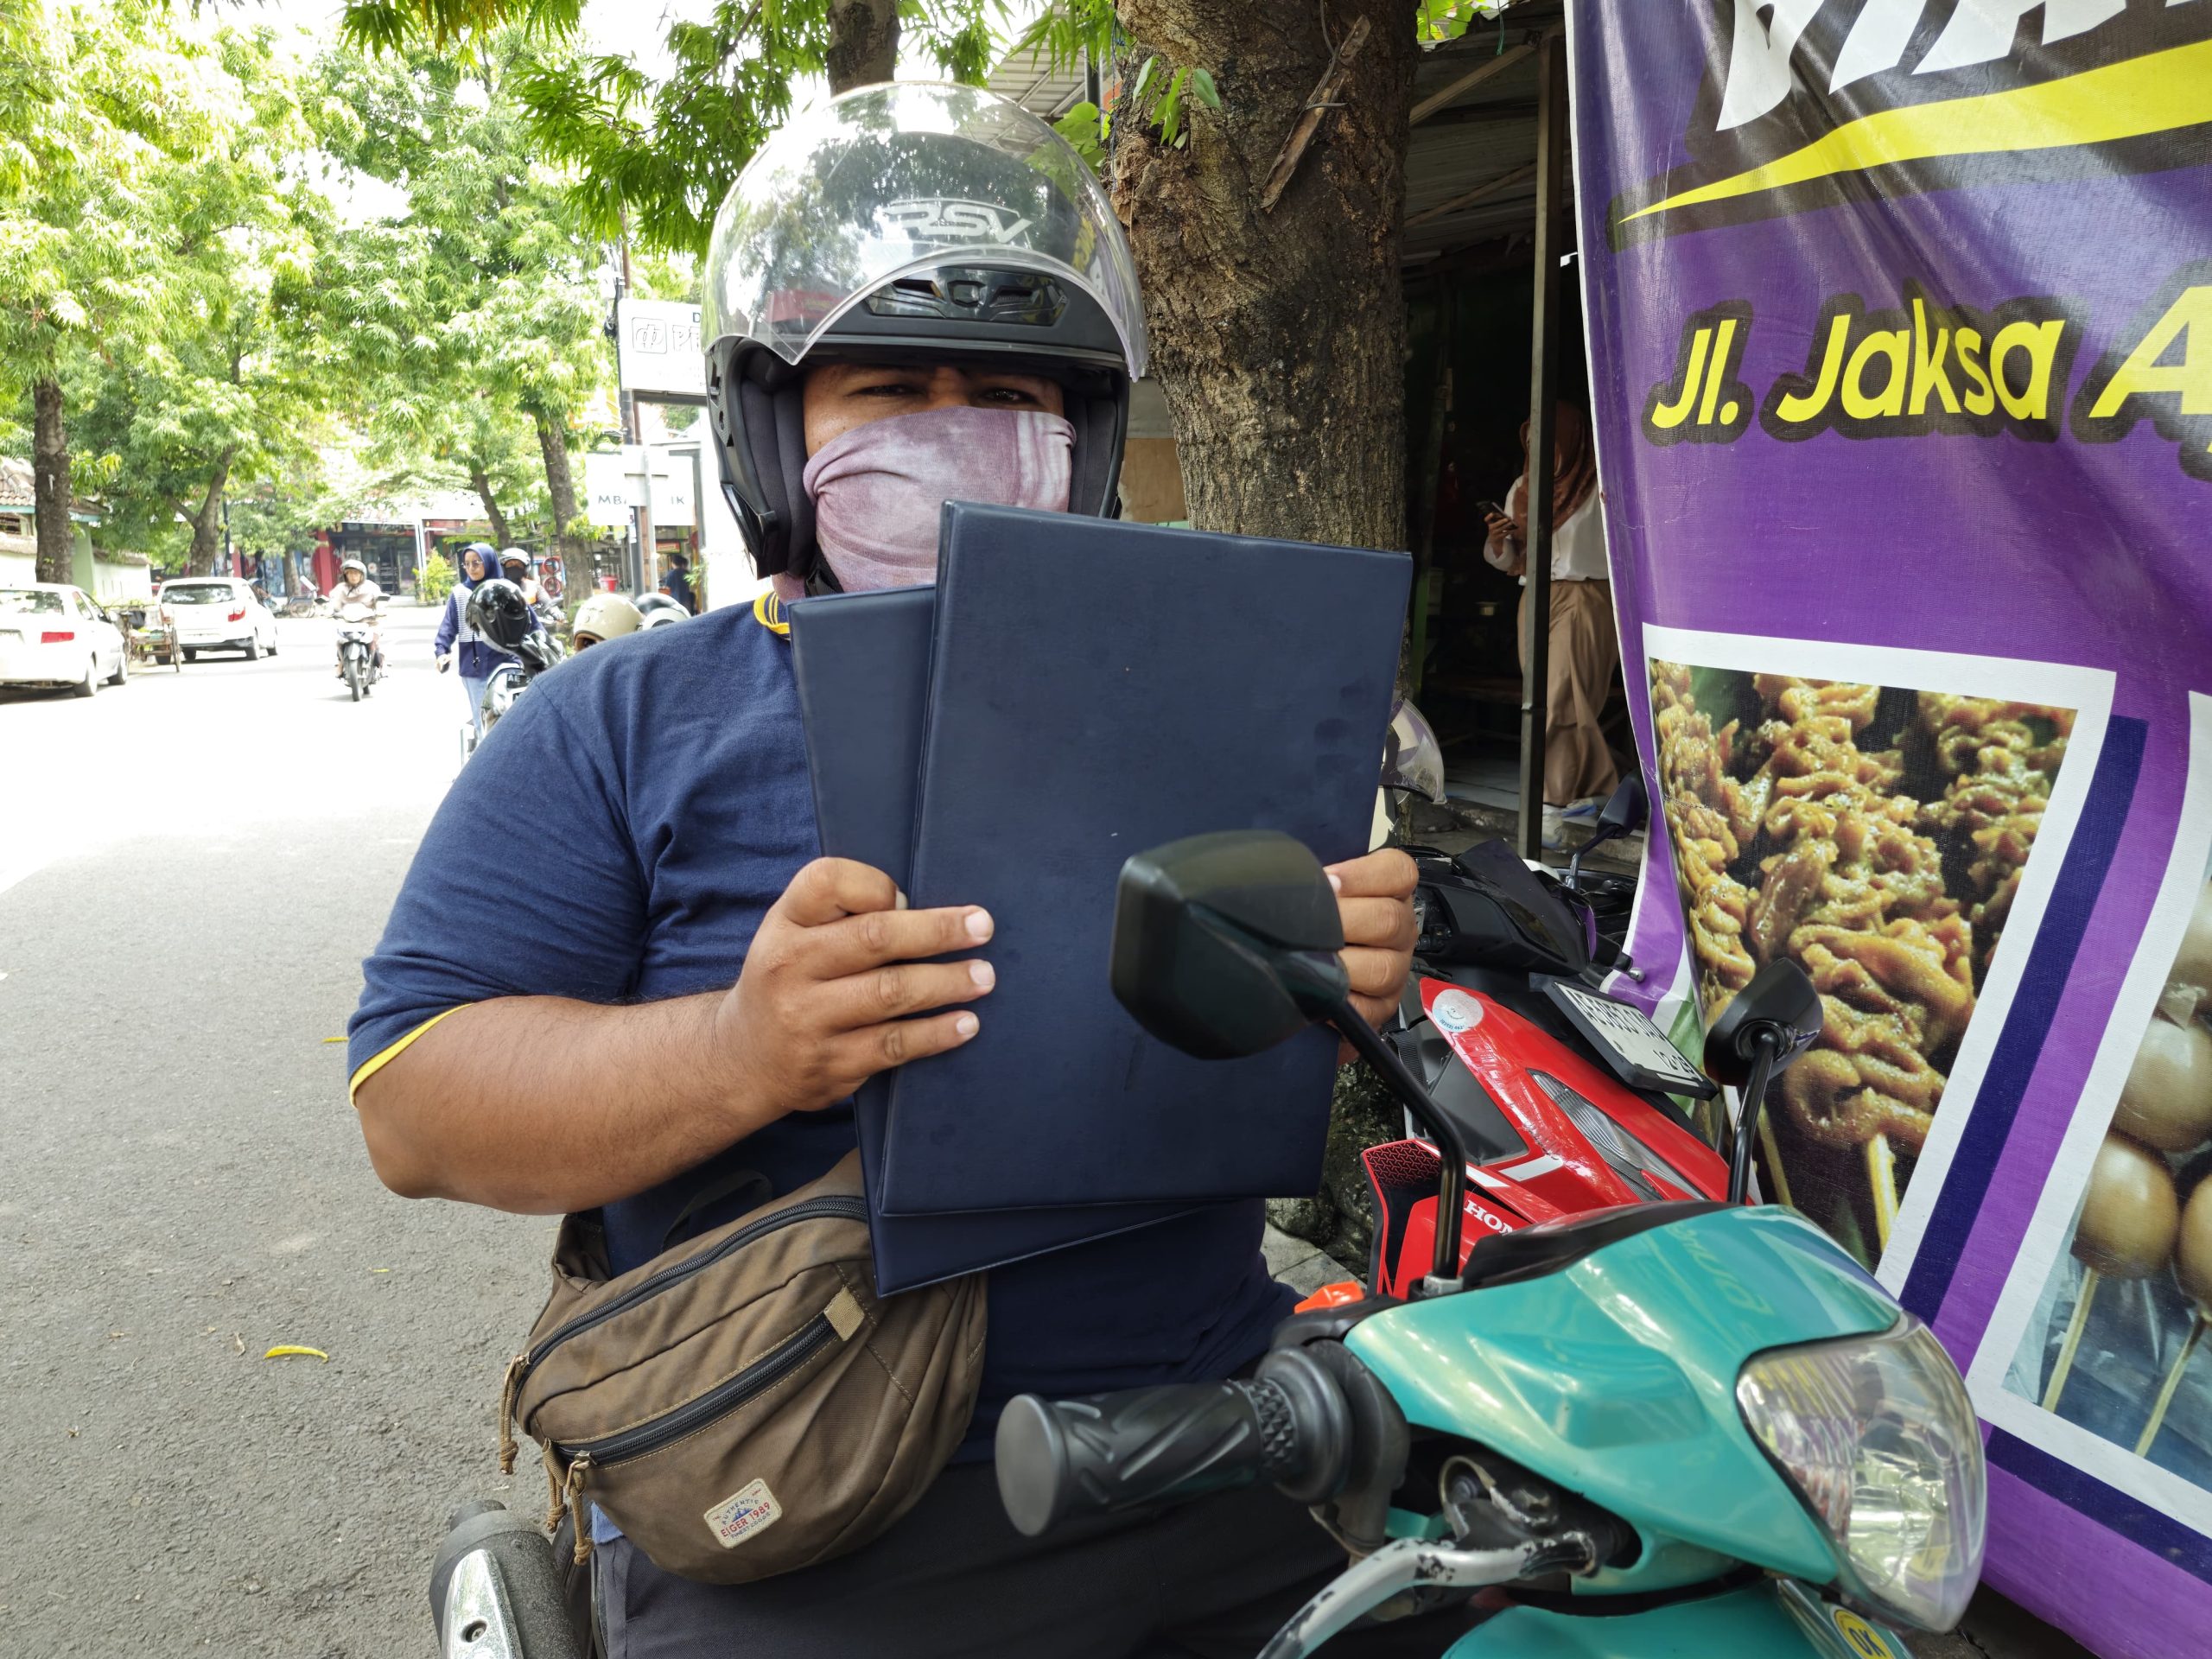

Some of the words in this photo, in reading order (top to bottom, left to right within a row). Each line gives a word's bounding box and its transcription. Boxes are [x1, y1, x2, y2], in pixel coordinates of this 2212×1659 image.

[878, 201, 1033, 244] RSV
[1651, 319, 1738, 429] Jl.
[1777, 298, 2065, 423] Jaksa
[2088, 285, 2212, 454] A
[721, 1498, 760, 1526] AUTHENTIC
[721, 1517, 749, 1537] EIGER
[748, 1502, 771, 1521] 1989
[1847, 1627, 1886, 1657] OK
